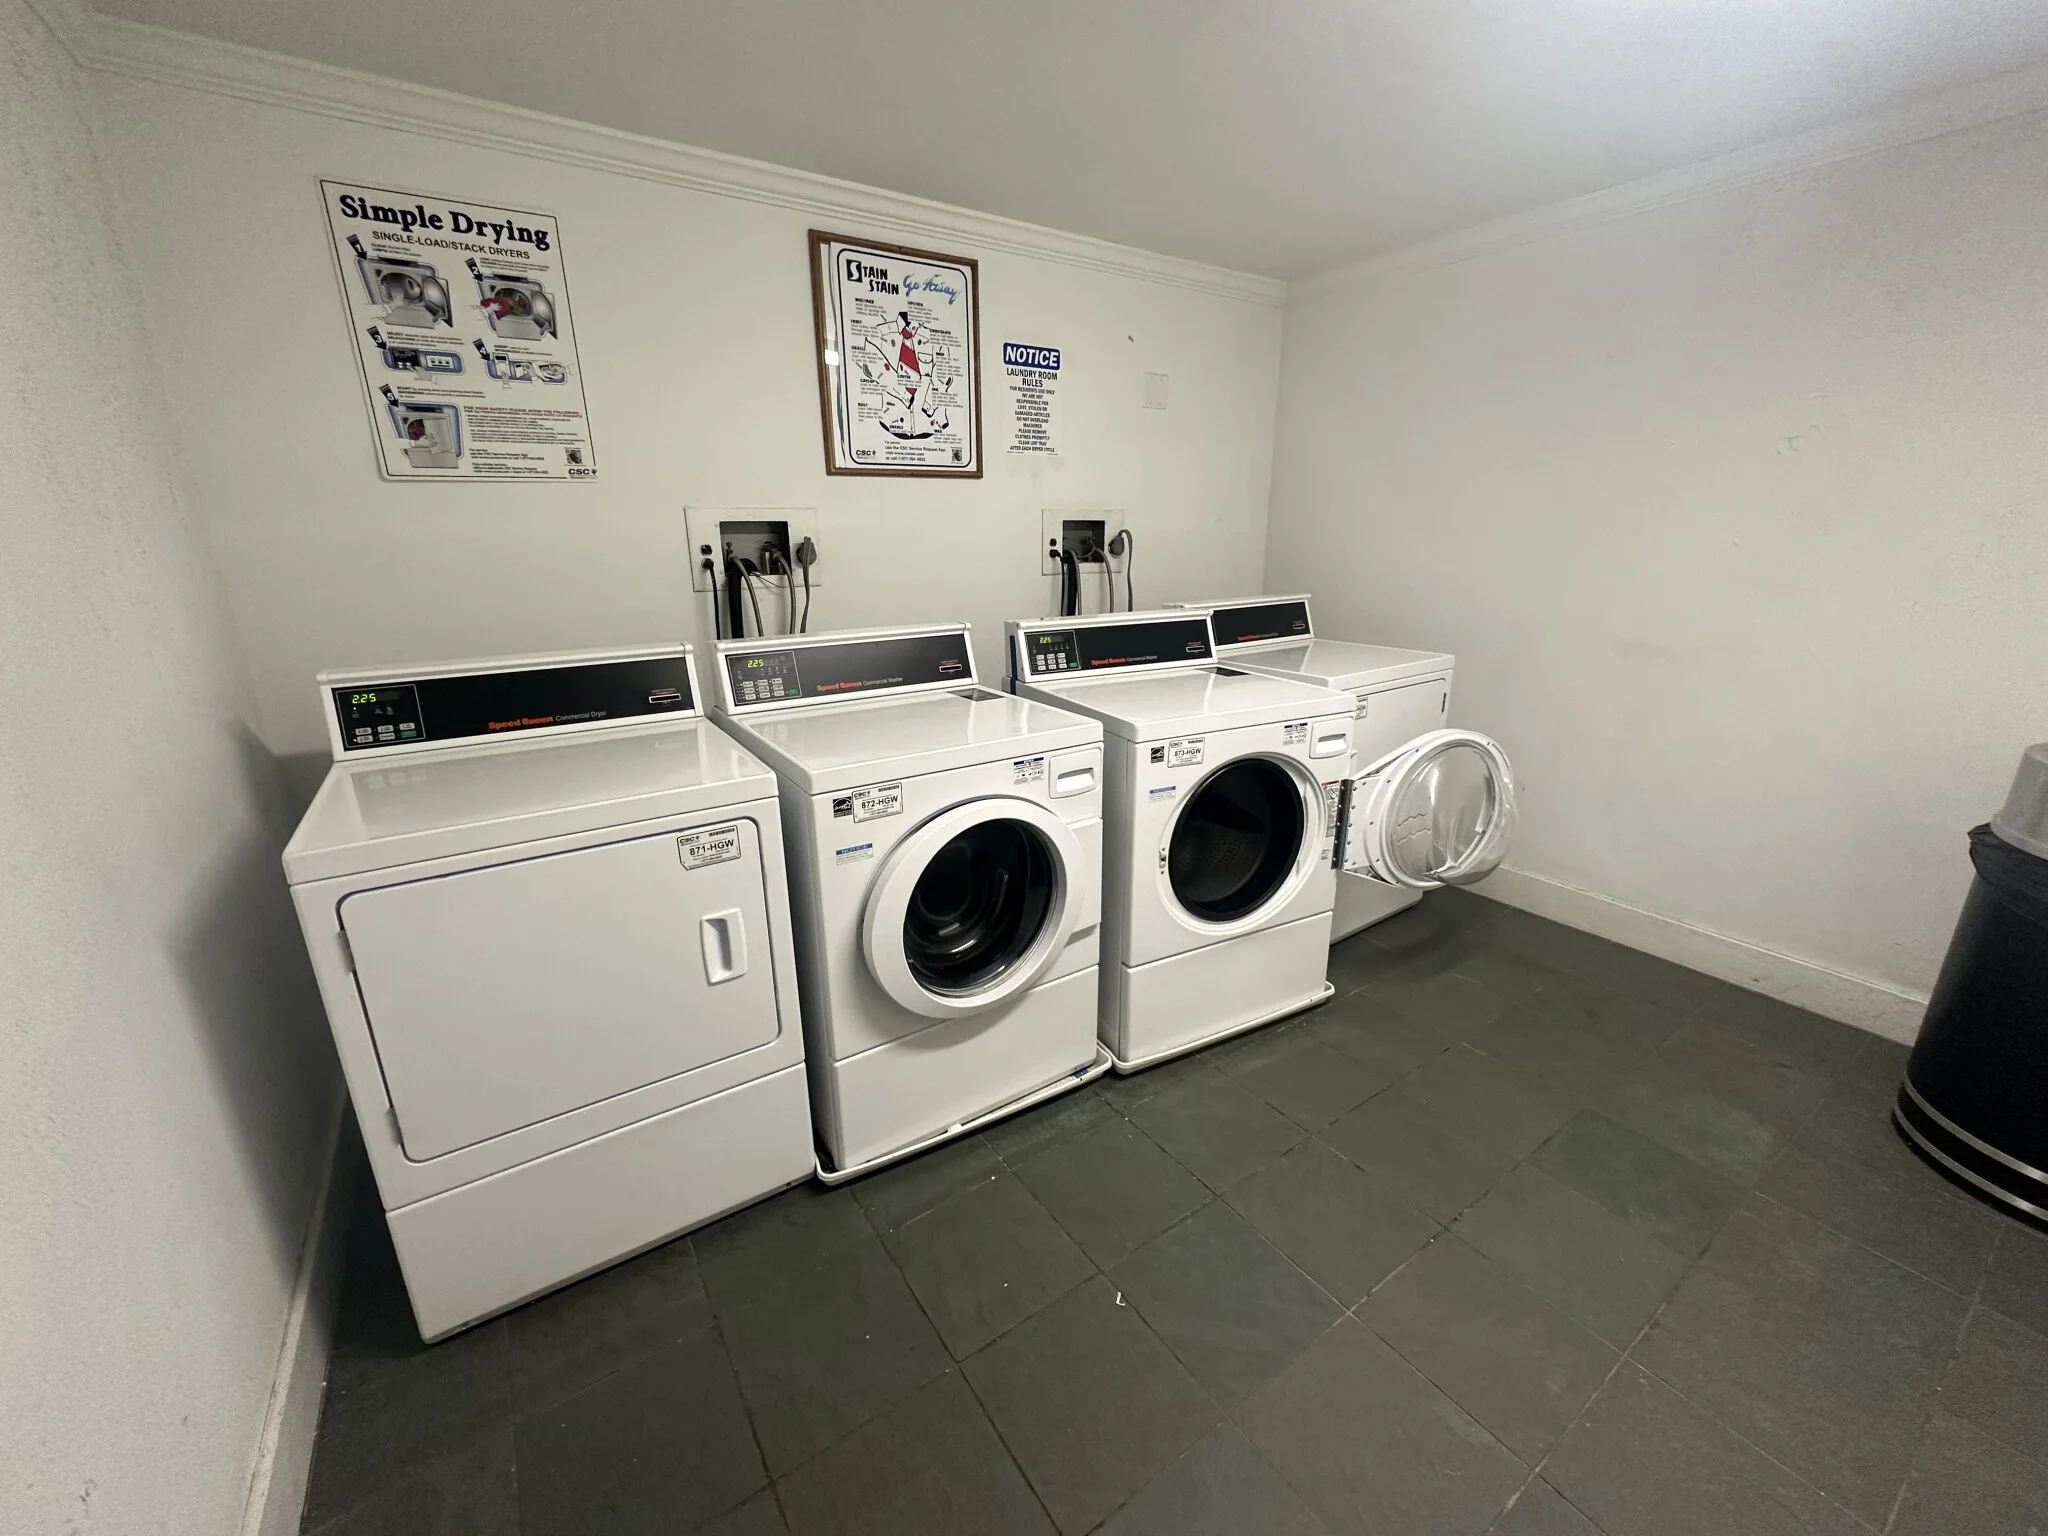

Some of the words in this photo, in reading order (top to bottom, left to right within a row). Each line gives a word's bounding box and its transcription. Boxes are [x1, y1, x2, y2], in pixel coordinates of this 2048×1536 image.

[339, 195, 444, 233] Simple
[448, 211, 550, 251] Drying
[372, 230, 487, 254] SINGLE-LOAD/STACK
[489, 246, 530, 259] DRYERS
[471, 266, 480, 275] 2
[847, 260, 888, 281] STAIN
[869, 280, 899, 295] STAIN
[903, 273, 920, 297] Go
[375, 334, 382, 343] 3
[1005, 346, 1059, 367] NOTICE
[1006, 368, 1037, 379] LAUNDRY
[1038, 371, 1058, 380] ROOM
[1022, 378, 1043, 387] RULES
[387, 392, 394, 401] 5
[816, 682, 839, 692] Speed
[840, 681, 863, 689] Queen
[488, 718, 521, 730] Speed
[522, 716, 554, 725] Queen
[555, 711, 590, 721] Commercial
[590, 710, 607, 719] Dryer
[861, 795, 898, 809] 872-HGW
[689, 839, 735, 856] 871-HGW
